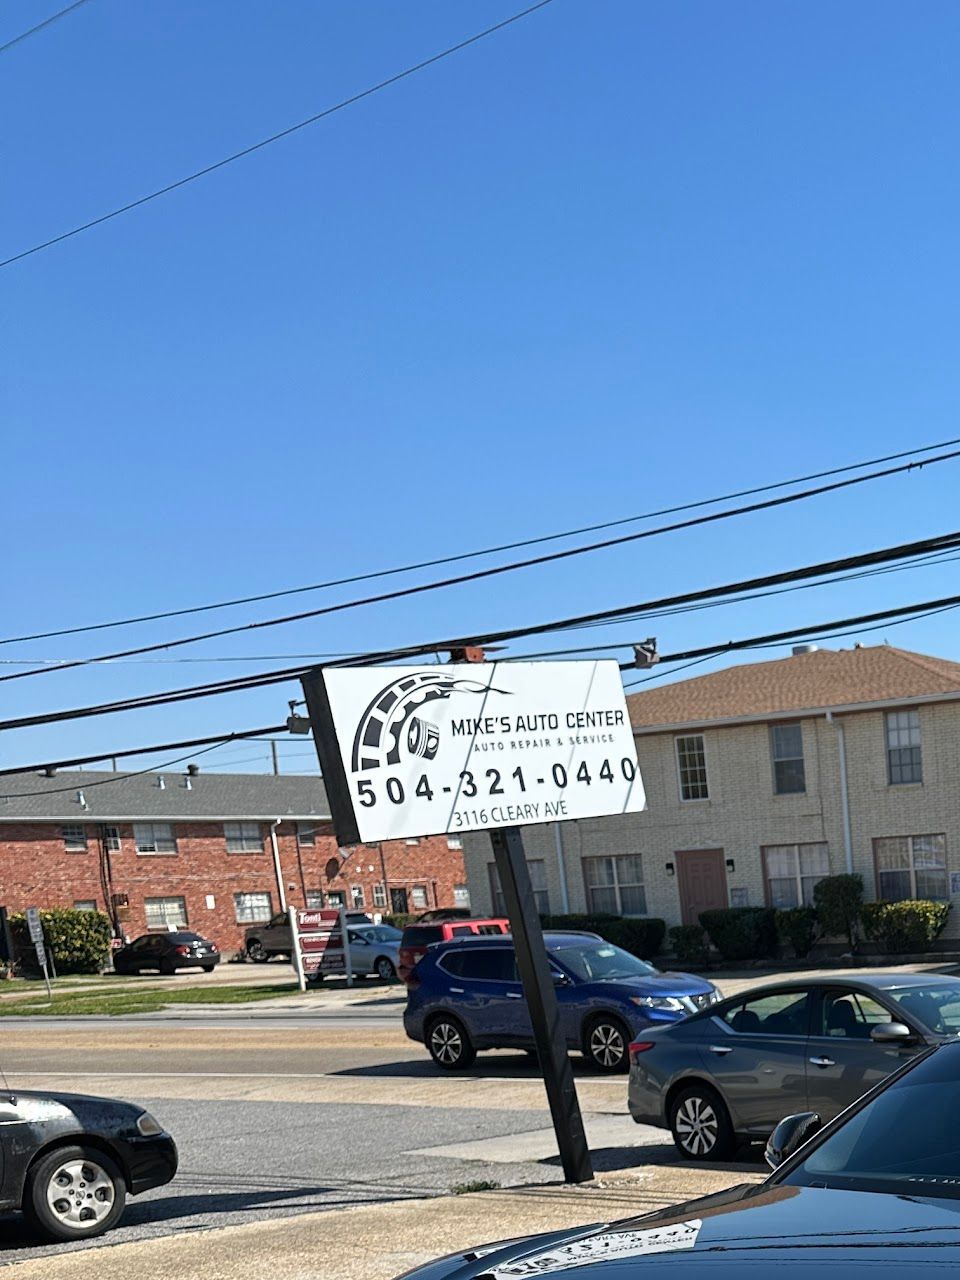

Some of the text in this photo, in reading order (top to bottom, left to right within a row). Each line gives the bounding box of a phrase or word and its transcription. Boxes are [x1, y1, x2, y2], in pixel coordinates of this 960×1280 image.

[451, 710, 624, 737] MIKE'S AUTO CENTER
[474, 734, 615, 752] AUTO REPAIR & SERVICE
[357, 757, 635, 808] 504-321-0440
[454, 800, 568, 827] 3116 CLEARY AVE
